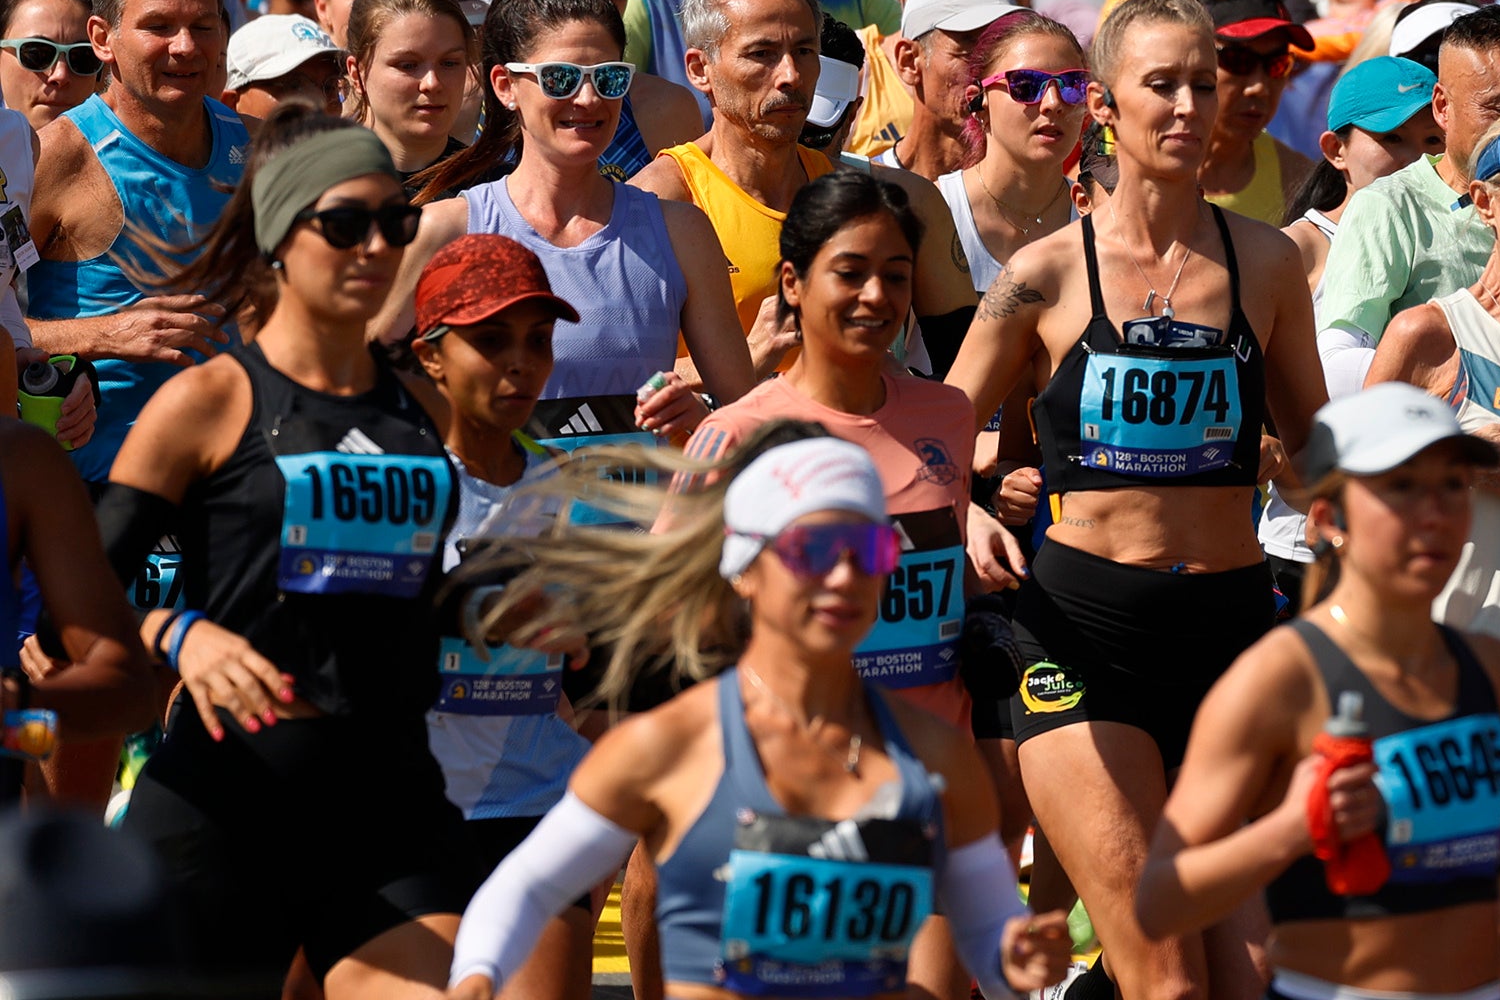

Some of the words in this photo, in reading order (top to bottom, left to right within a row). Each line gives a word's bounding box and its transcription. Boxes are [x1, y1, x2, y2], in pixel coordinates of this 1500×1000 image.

[1101, 366, 1230, 426] 16874
[1087, 426, 1095, 438] 1
[1140, 452, 1187, 464] BOSTON
[1115, 460, 1187, 473] MARATHON
[303, 463, 435, 526] 16509
[880, 557, 956, 624] 657
[876, 652, 922, 667] BOSTON
[495, 681, 532, 690] BOSTON
[471, 691, 532, 701] MARATHON
[754, 871, 914, 942] 16130
